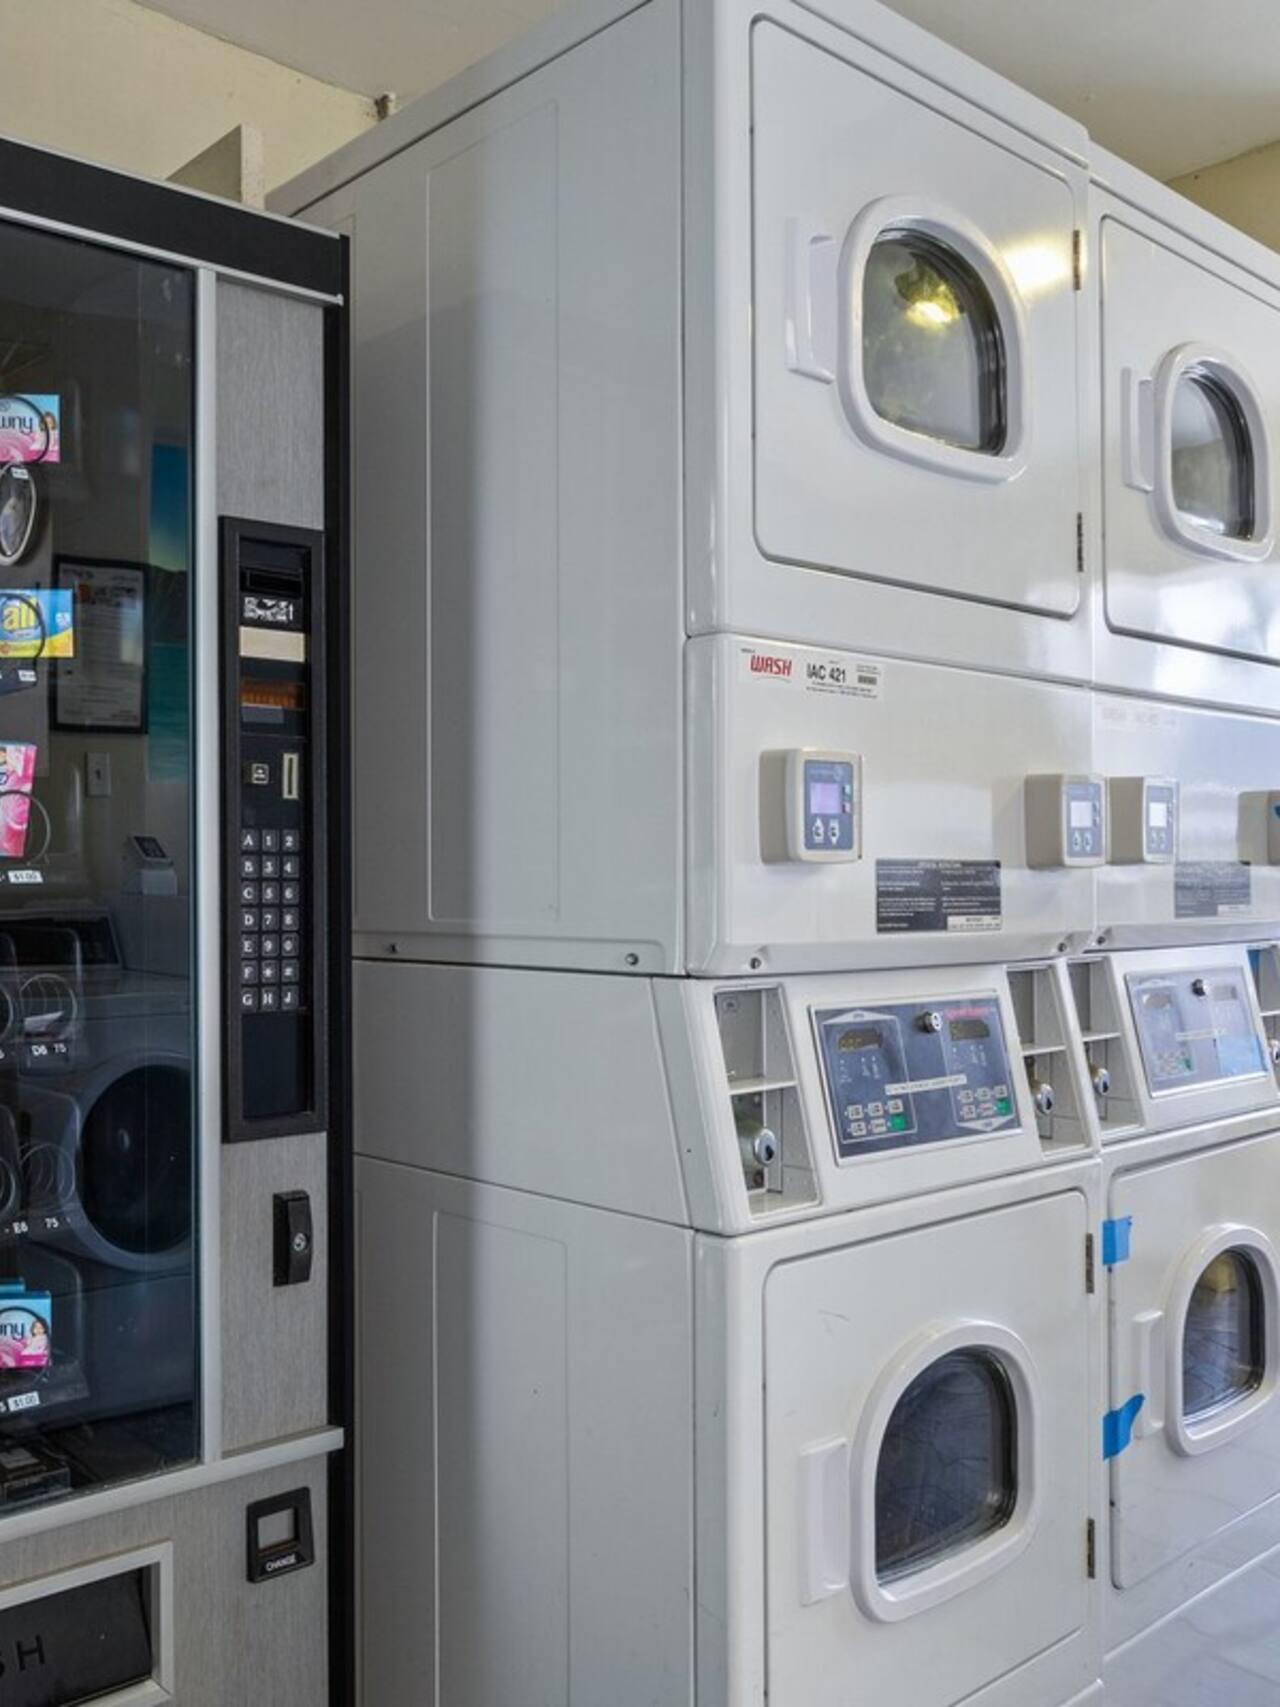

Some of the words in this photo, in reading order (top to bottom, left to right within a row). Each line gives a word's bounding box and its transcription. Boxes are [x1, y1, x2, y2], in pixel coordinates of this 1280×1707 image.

[3, 596, 38, 631] all
[750, 655, 793, 676] WASH
[828, 665, 847, 683] 421
[243, 836, 254, 846] A
[265, 836, 272, 846] 1
[285, 836, 293, 846] 2
[244, 861, 254, 873] B
[283, 861, 292, 873] 4
[243, 888, 253, 899] C
[284, 888, 293, 899] 6
[244, 914, 254, 926] D
[264, 914, 272, 926] 7
[284, 914, 293, 926] 8
[244, 940, 253, 952] E
[244, 967, 253, 978] F
[242, 993, 253, 1005] G
[263, 993, 273, 1005] H
[284, 993, 292, 1005] J
[32, 1044, 48, 1056] D6
[54, 1042, 68, 1053] 75
[45, 1217, 60, 1230] 75
